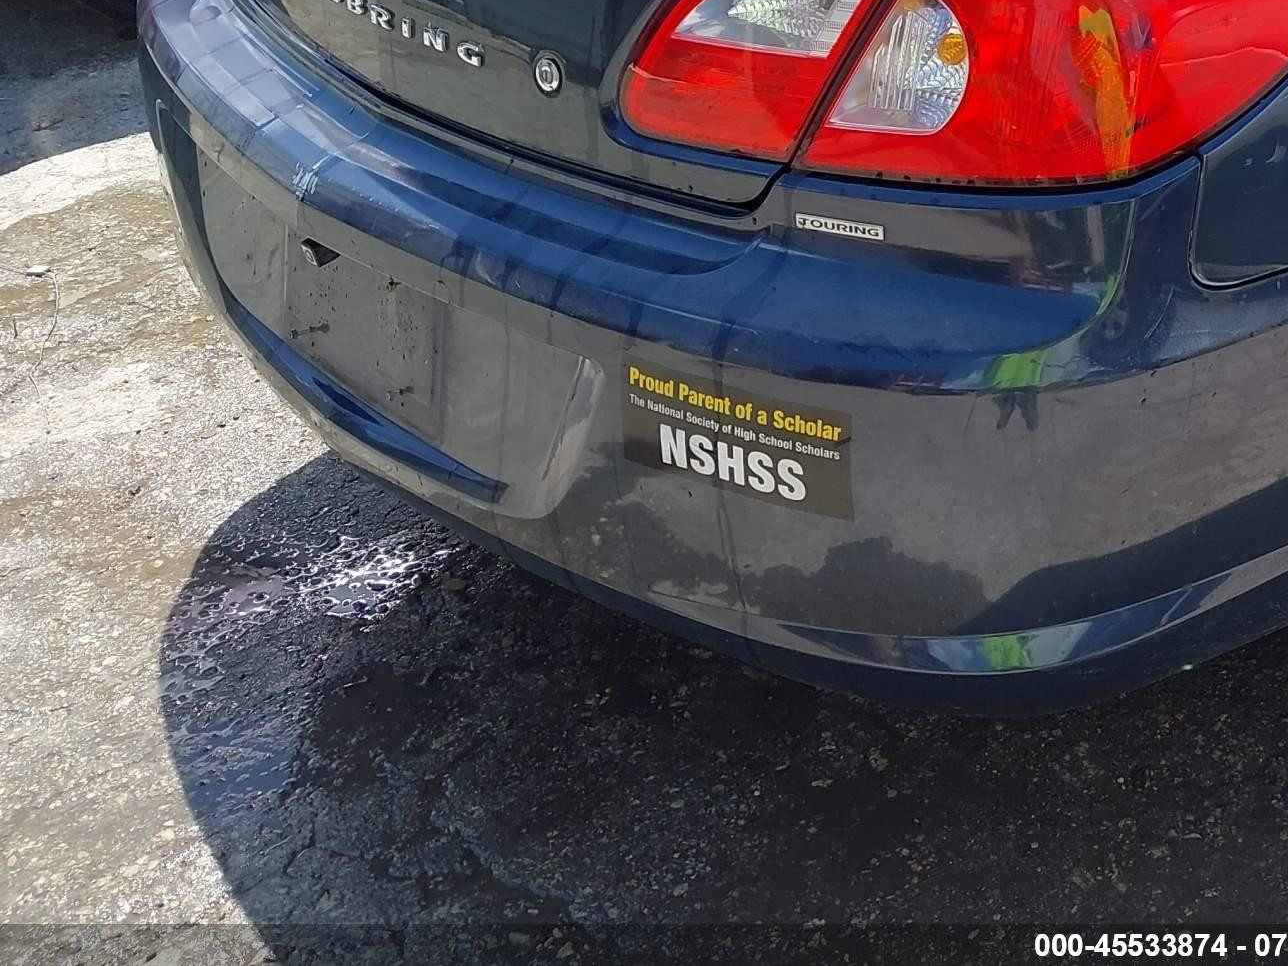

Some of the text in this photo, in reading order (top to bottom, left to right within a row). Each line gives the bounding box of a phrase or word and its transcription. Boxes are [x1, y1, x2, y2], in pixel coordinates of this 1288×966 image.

[797, 217, 880, 237] TOURING
[629, 366, 842, 442] Proud Parent of a Scholar
[629, 393, 841, 460] The National Society of High School Scholars
[659, 422, 807, 501] NSHSS
